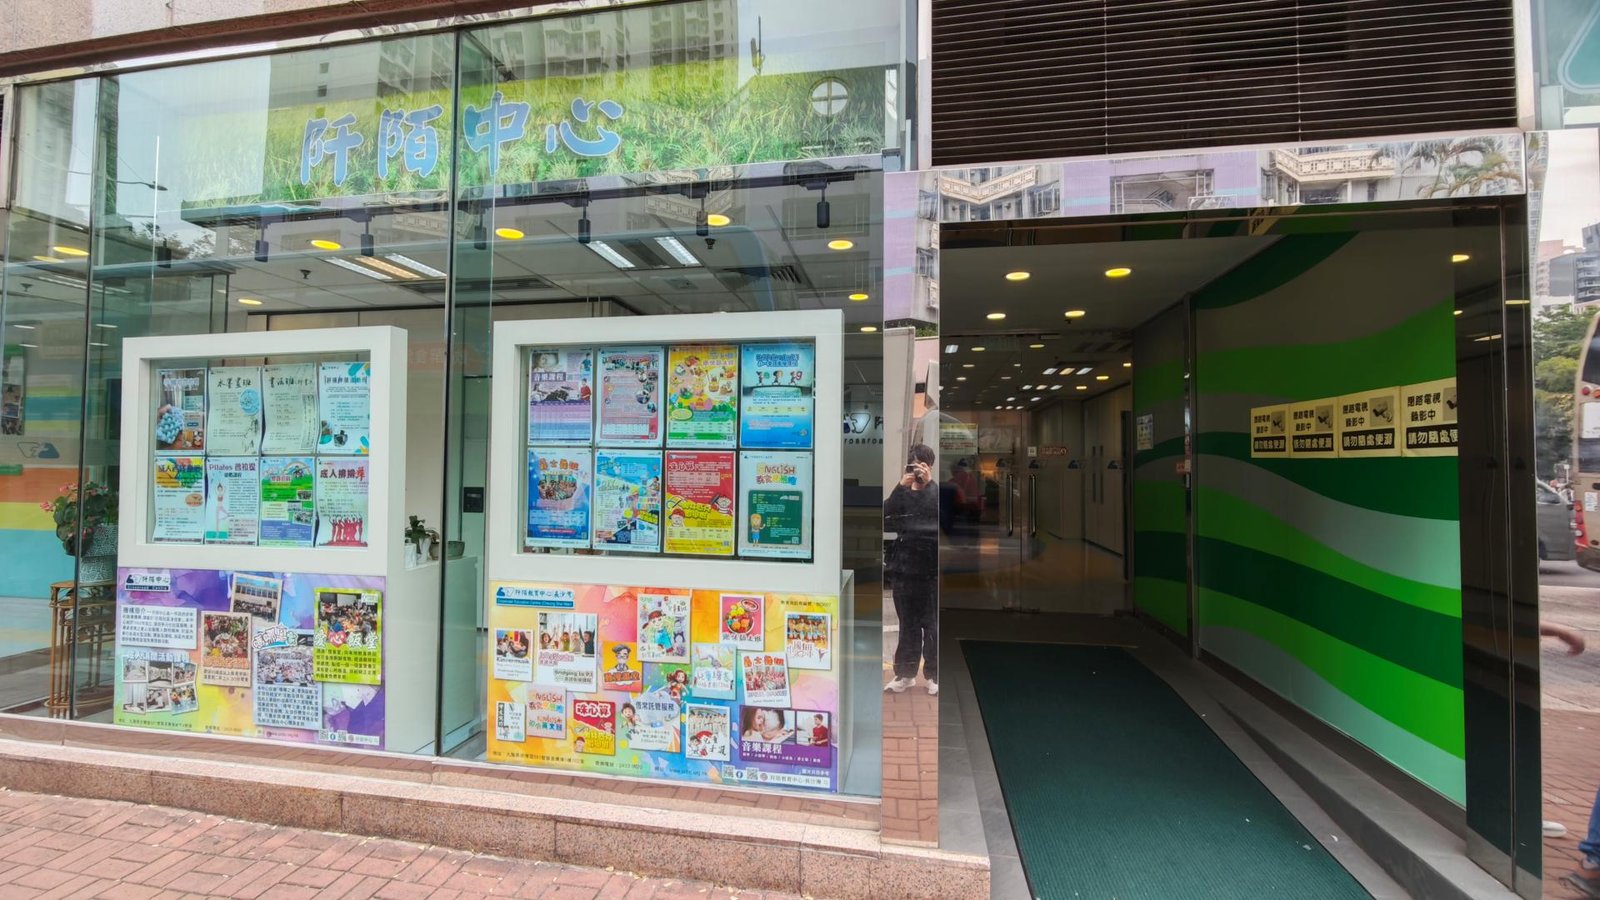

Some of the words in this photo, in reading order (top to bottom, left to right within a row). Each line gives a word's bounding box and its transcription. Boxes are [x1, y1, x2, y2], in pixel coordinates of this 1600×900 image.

[301, 91, 623, 187] 阡陌中心
[1407, 392, 1441, 407] 閉路電視
[1411, 409, 1436, 421] 錄影中
[1408, 429, 1458, 444] 請勿隨處便
[575, 703, 611, 717] 珠心算
[742, 742, 783, 755] 音樂課程
